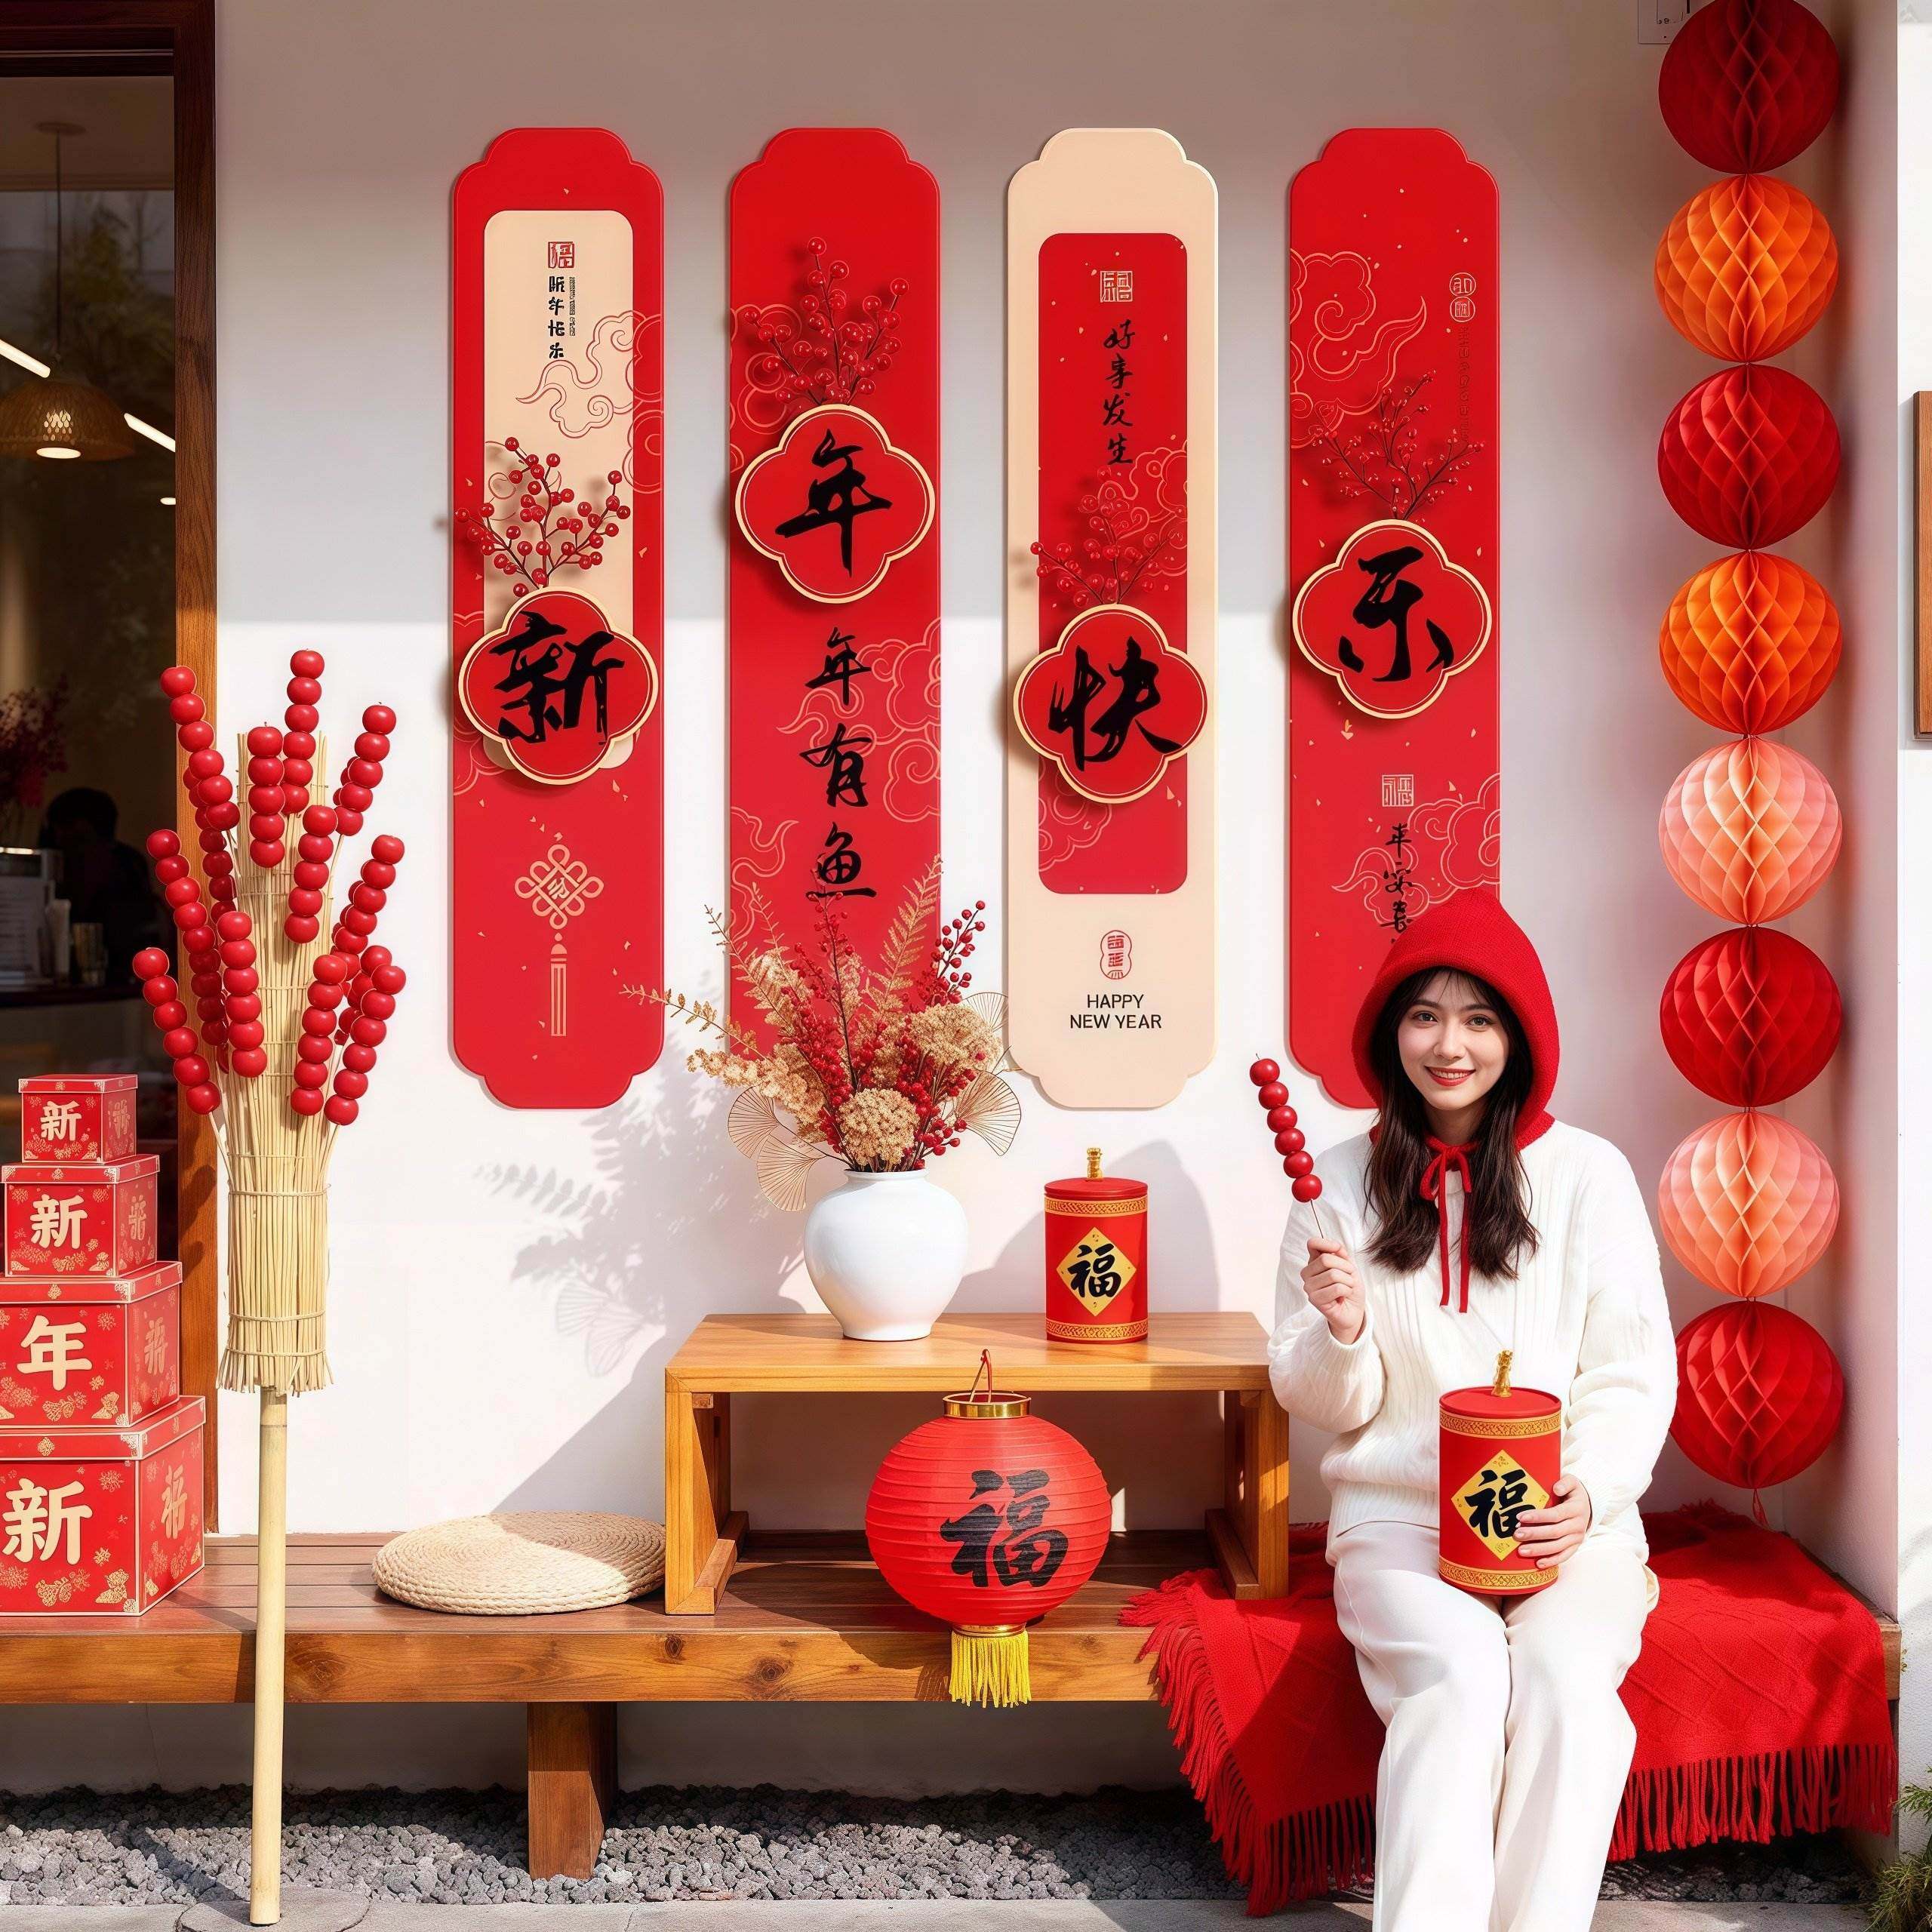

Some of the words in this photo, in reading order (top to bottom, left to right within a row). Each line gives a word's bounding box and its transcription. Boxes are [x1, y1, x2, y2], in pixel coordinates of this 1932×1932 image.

[1103, 318, 1136, 466] 好事发生
[774, 428, 894, 578] 年
[488, 610, 626, 746] 新
[1048, 635, 1184, 772] 快
[798, 626, 878, 898] 年有鱼
[1069, 1014, 1111, 1029] NEW
[1115, 1014, 1162, 1029] YEAR
[1087, 993, 1144, 1009] HAPPY
[39, 1100, 82, 1141] 新
[29, 1193, 88, 1250] 新
[1067, 1243, 1122, 1299] 福
[17, 1314, 93, 1392] 年
[2, 1477, 94, 1566] 新
[940, 1469, 1069, 1588] 福
[1464, 1469, 1537, 1540] 福
